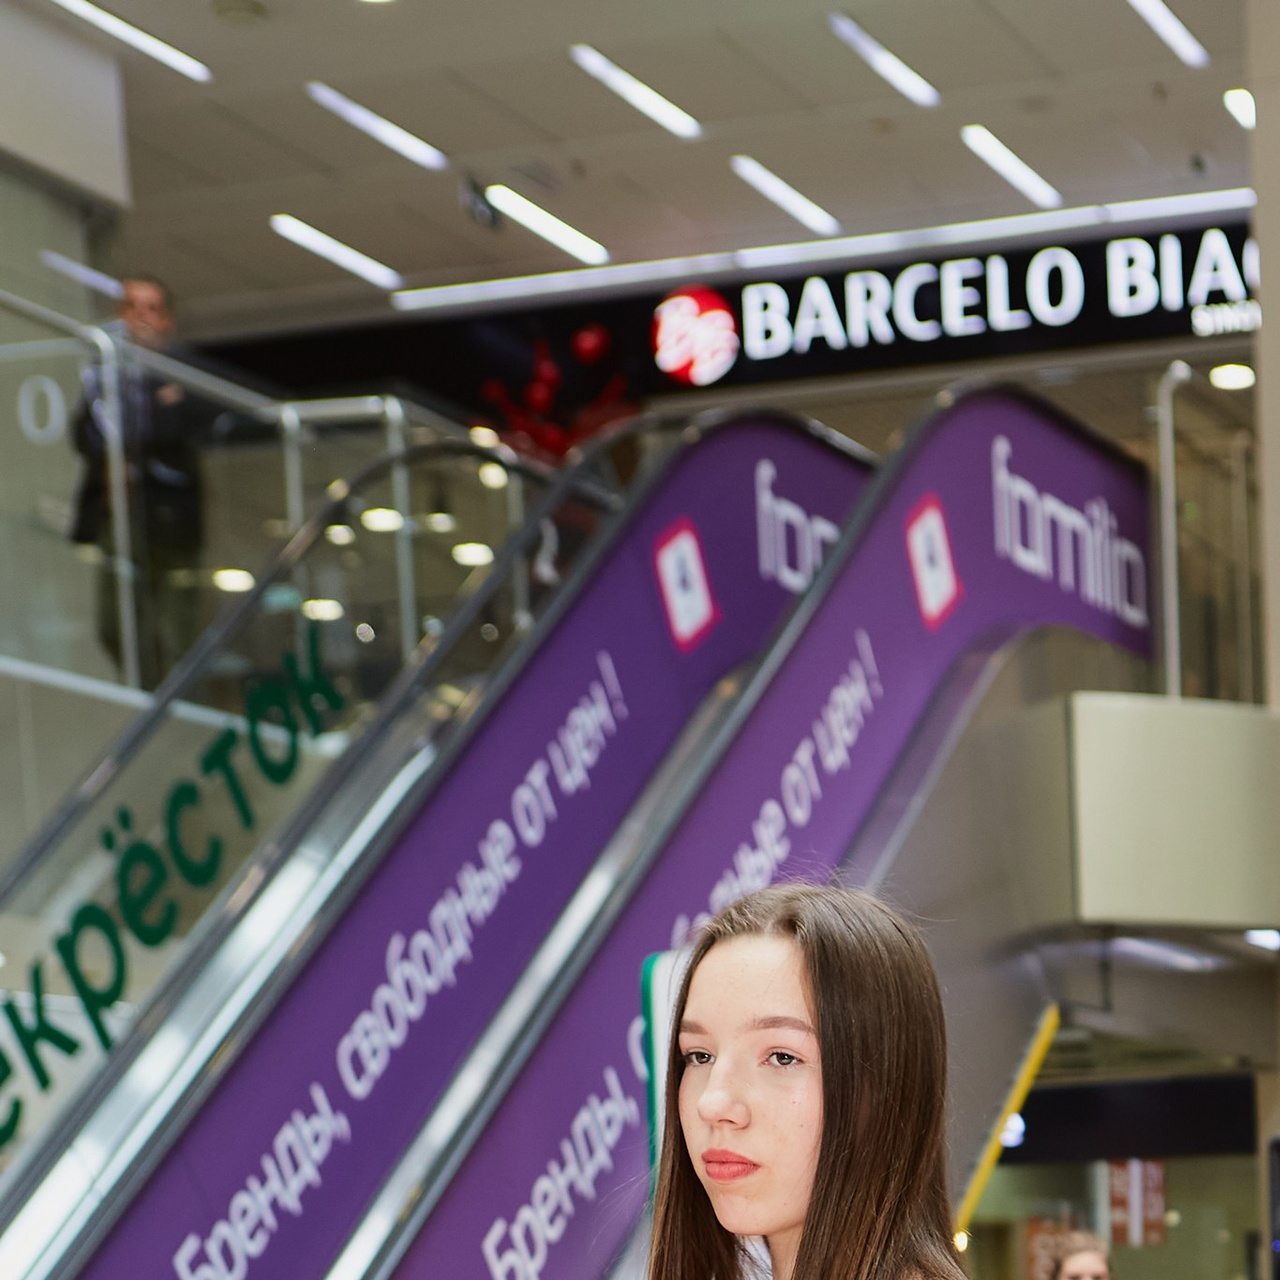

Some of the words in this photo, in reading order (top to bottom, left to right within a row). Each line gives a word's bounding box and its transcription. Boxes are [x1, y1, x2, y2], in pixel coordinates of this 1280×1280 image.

[741, 246, 1085, 361] BARCELO
[511, 758, 557, 847] от
[780, 738, 822, 828] от
